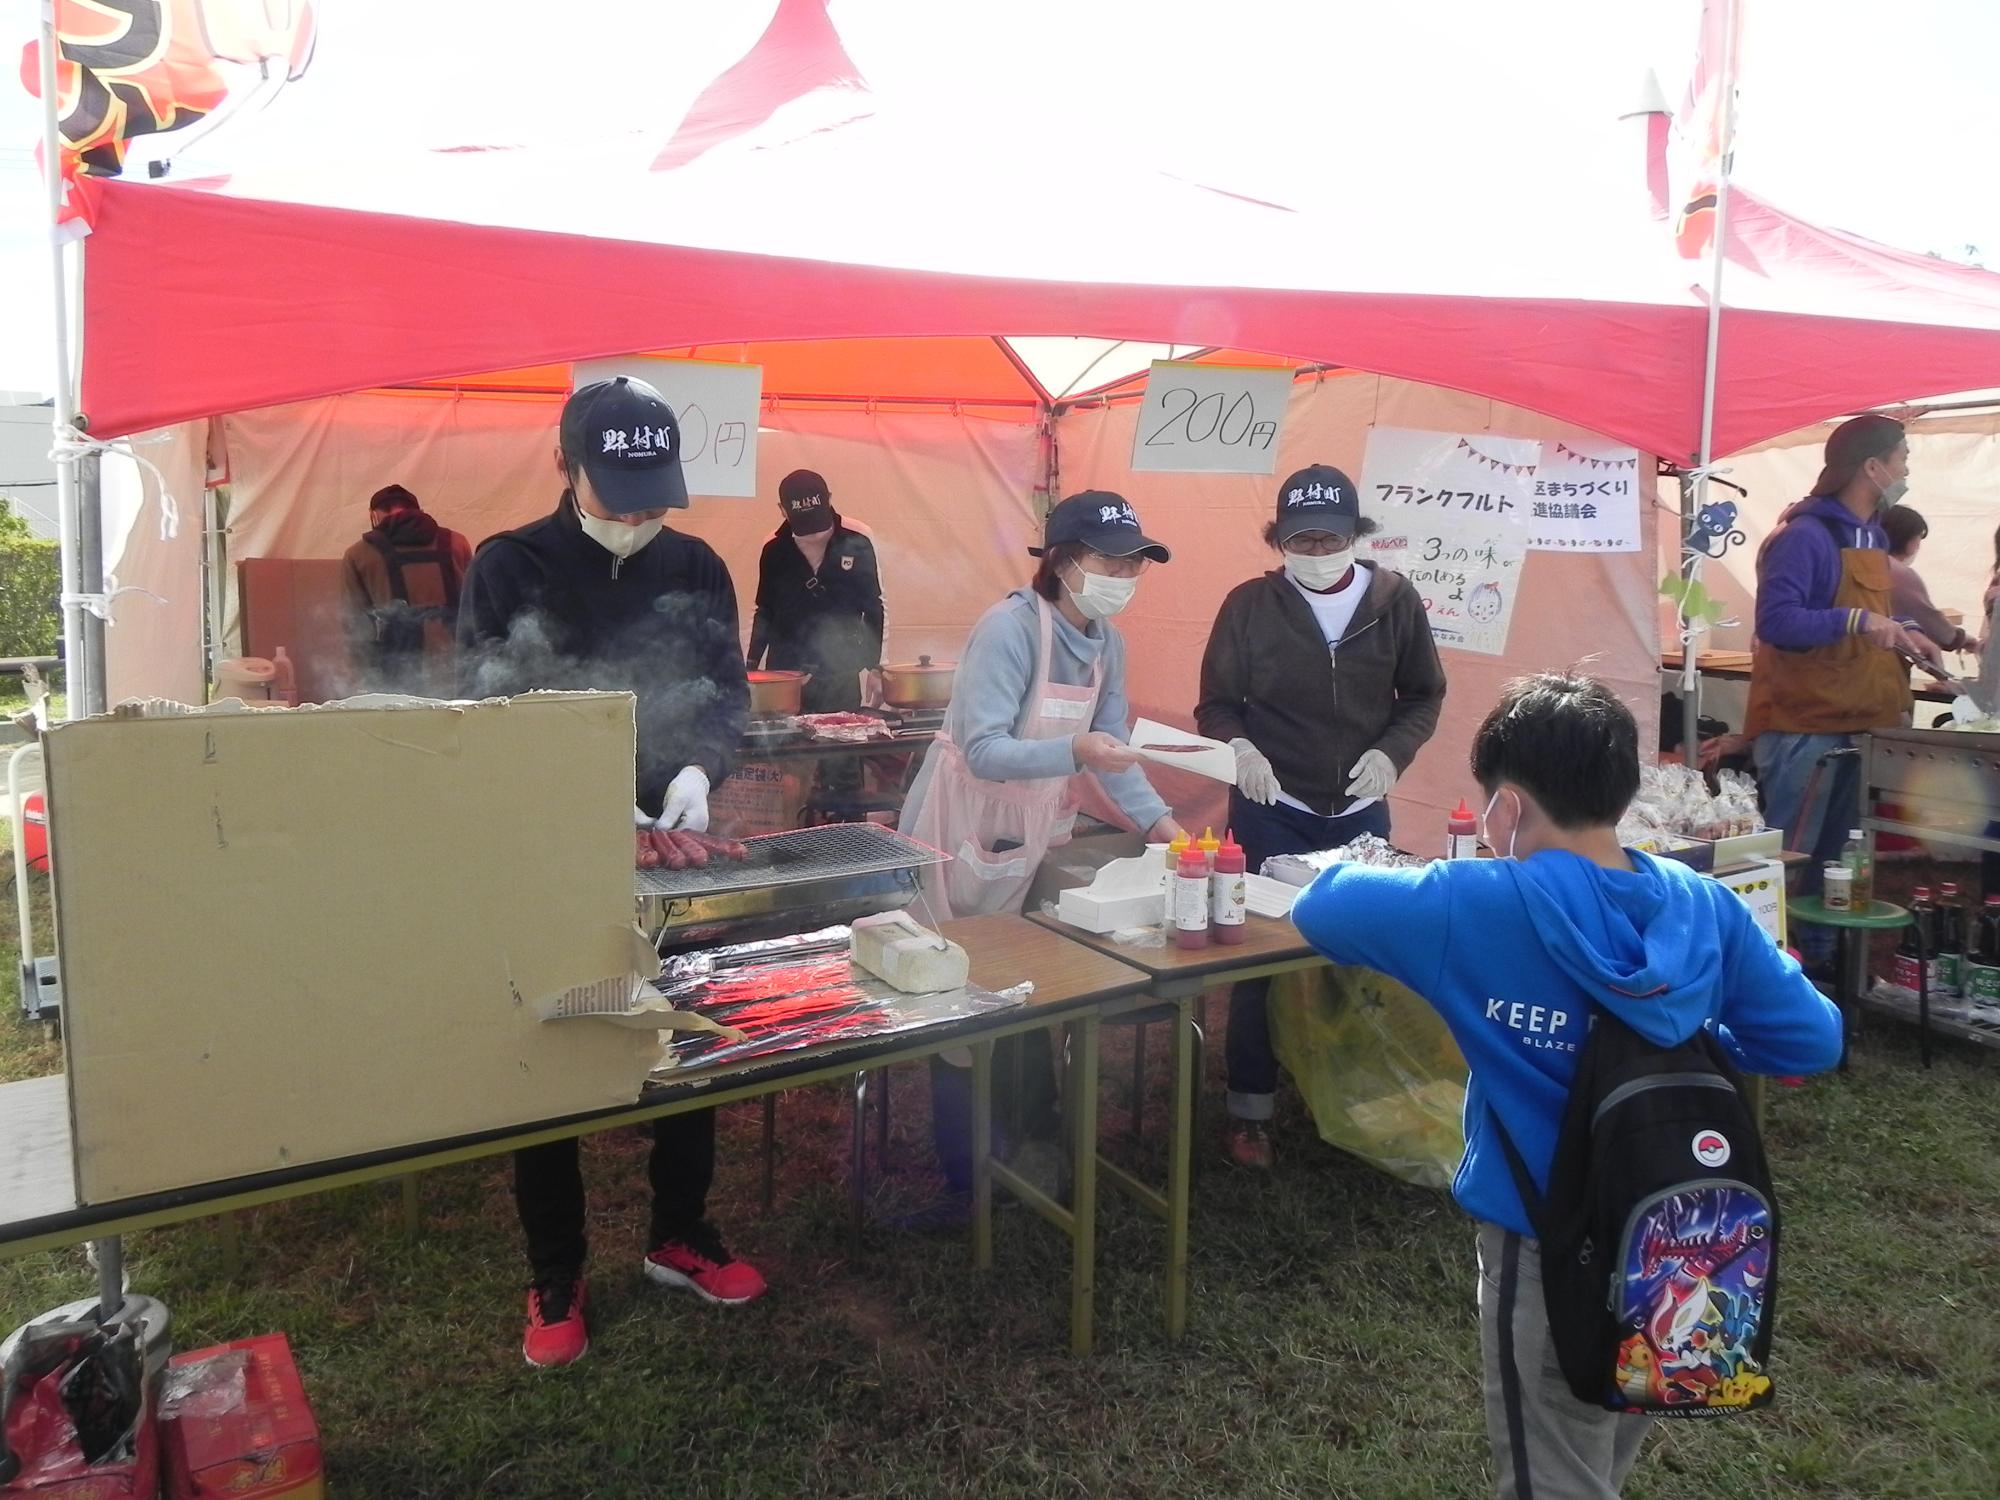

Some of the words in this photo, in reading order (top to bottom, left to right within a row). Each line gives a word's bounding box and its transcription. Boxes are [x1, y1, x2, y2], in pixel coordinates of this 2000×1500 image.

[1145, 387, 1277, 450] 200円
[602, 425, 671, 457] 野村町
[1287, 482, 1341, 507] 野村町
[1376, 484, 1514, 513] フランクフルト
[1533, 502, 1597, 519] 進協議会
[1485, 997, 1568, 1035] KEEP
[1522, 1036, 1576, 1053] BLAZE
